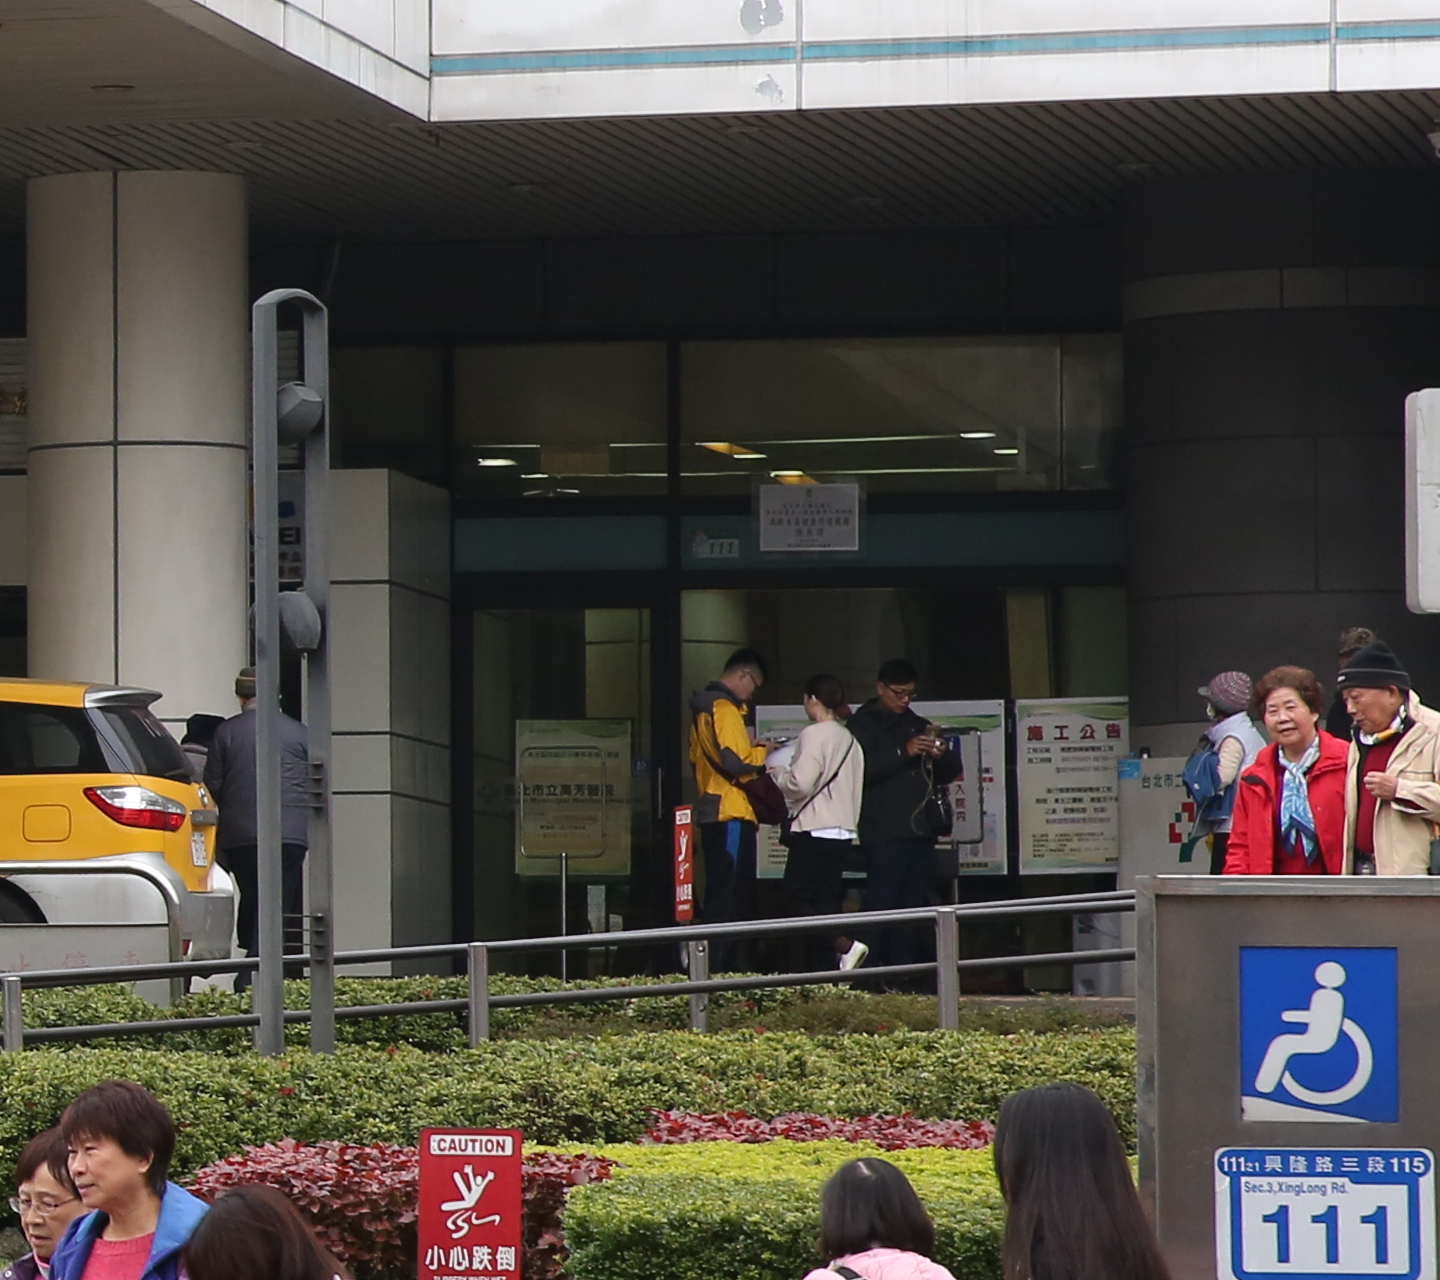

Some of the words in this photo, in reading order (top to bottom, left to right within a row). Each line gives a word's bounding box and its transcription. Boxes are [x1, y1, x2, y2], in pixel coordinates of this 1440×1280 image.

[1026, 723, 1122, 742] 施工公告
[436, 1137, 507, 1154] CAUTION
[1264, 1155, 1386, 1174] 興隆路三段
[1390, 1157, 1425, 1173] 115
[1244, 1181, 1328, 1196] Sec.3,XingLong
[1331, 1183, 1348, 1195] Rd.
[1261, 1204, 1389, 1265] 111
[425, 1244, 516, 1272] 小心跌倒
